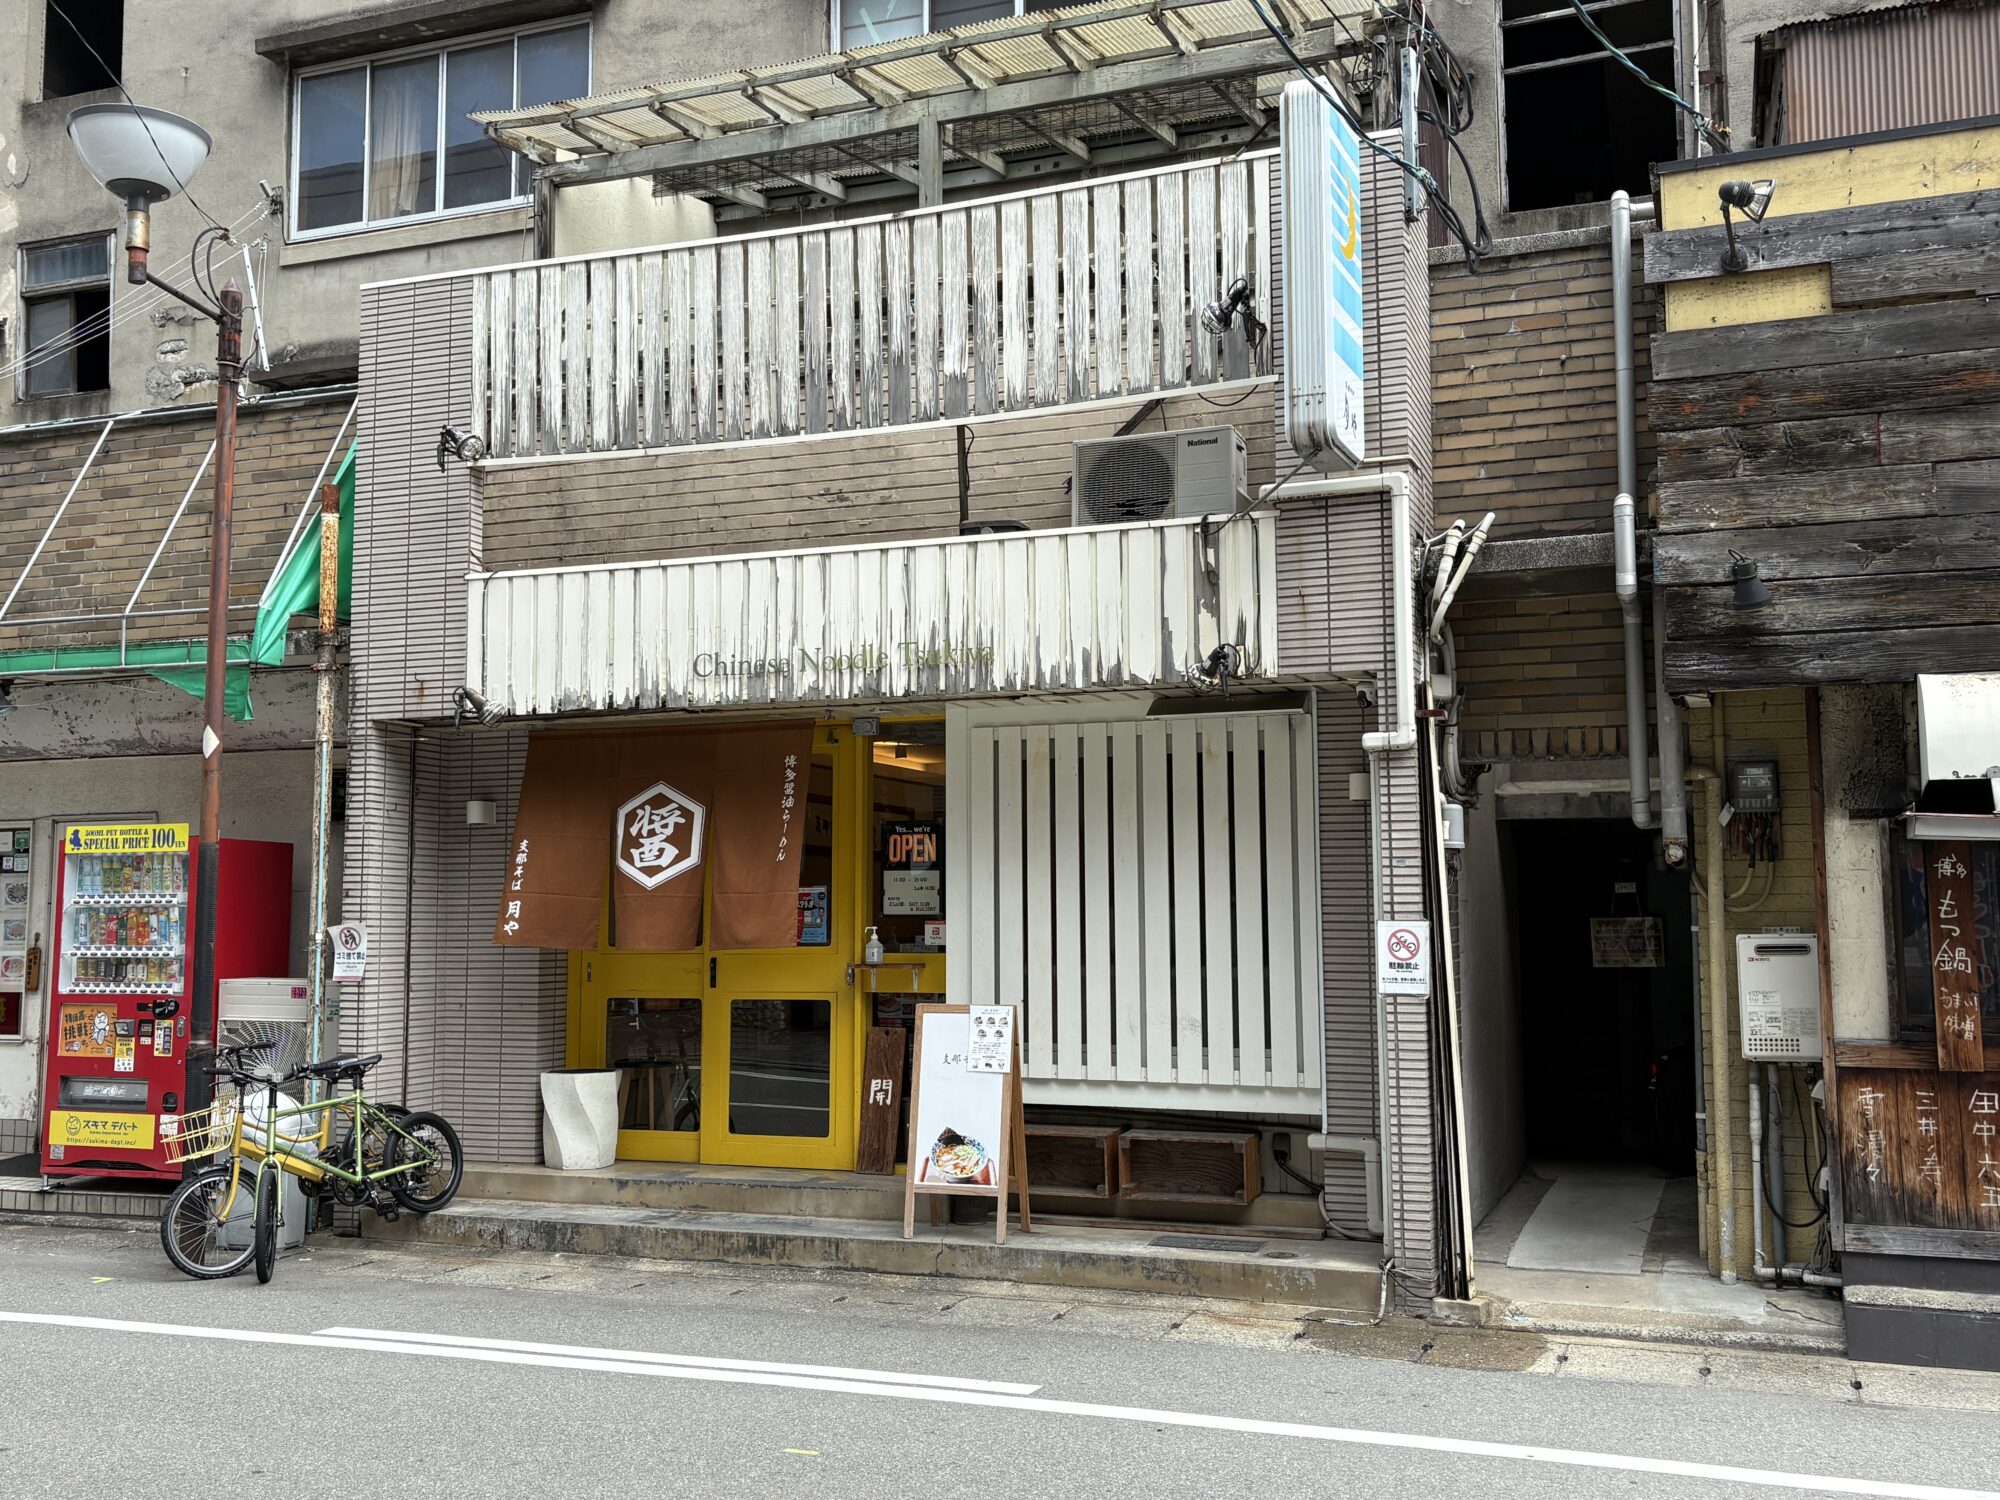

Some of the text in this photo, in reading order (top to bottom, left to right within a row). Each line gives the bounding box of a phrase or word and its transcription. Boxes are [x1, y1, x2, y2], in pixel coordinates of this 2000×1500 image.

[1187, 436, 1218, 447] National
[693, 639, 995, 678] Chinese Noodle Tsukiya
[83, 827, 186, 850] SPECIAL PRICE 100 YEN
[913, 825, 931, 833] we're
[888, 833, 937, 863] OPEN
[1933, 853, 1967, 879] 博多
[502, 839, 529, 936] 支那そば 月や
[1934, 889, 1972, 974] もつ鍋
[336, 951, 365, 960] ゴミ捨て禁止
[1388, 962, 1420, 970] 駐輪禁止
[1944, 1012, 1976, 1040] 味噌
[869, 1078, 893, 1106] 開
[82, 1120, 138, 1131] スキマ デパート
